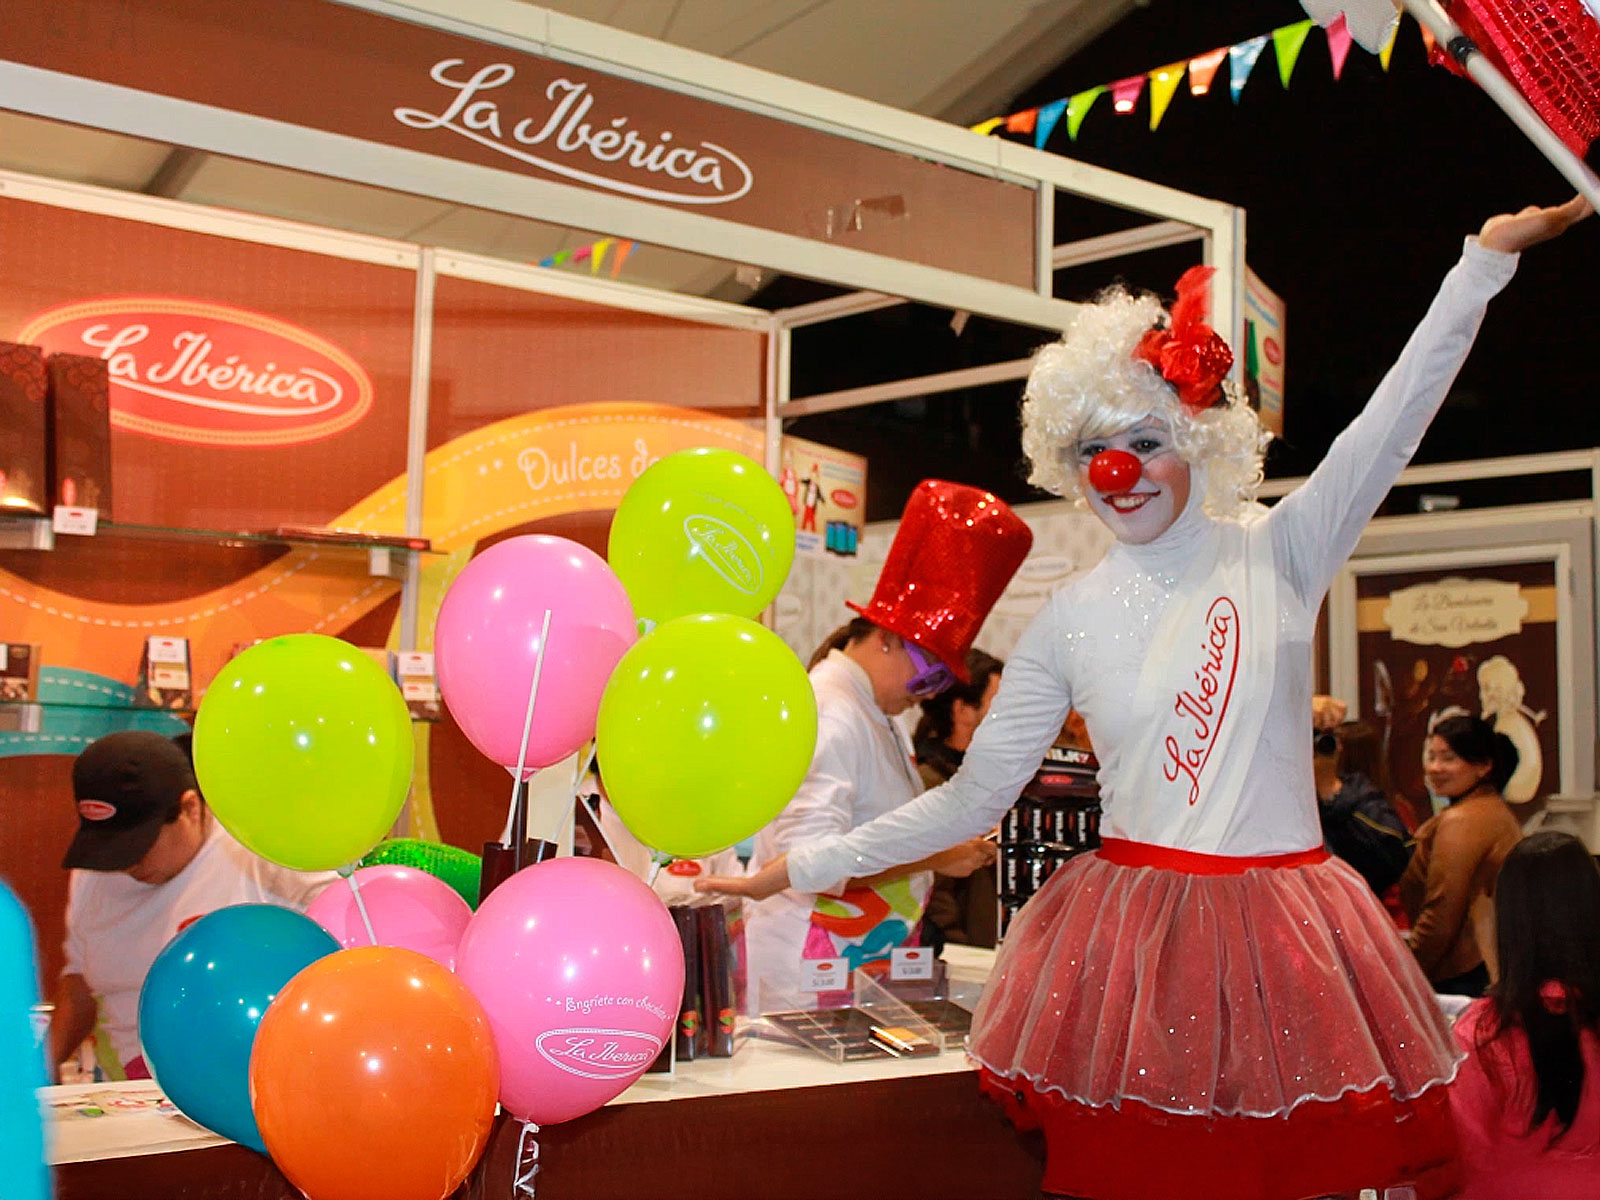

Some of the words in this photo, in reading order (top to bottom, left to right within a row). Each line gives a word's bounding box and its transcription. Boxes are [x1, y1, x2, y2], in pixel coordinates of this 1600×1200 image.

[394, 58, 515, 138] La
[513, 78, 726, 192] Ibérica
[146, 331, 319, 404] Ibérica
[517, 440, 622, 491] Dulces
[1174, 614, 1232, 741] Ibérica
[1163, 735, 1206, 806] La
[549, 1036, 594, 1059] La
